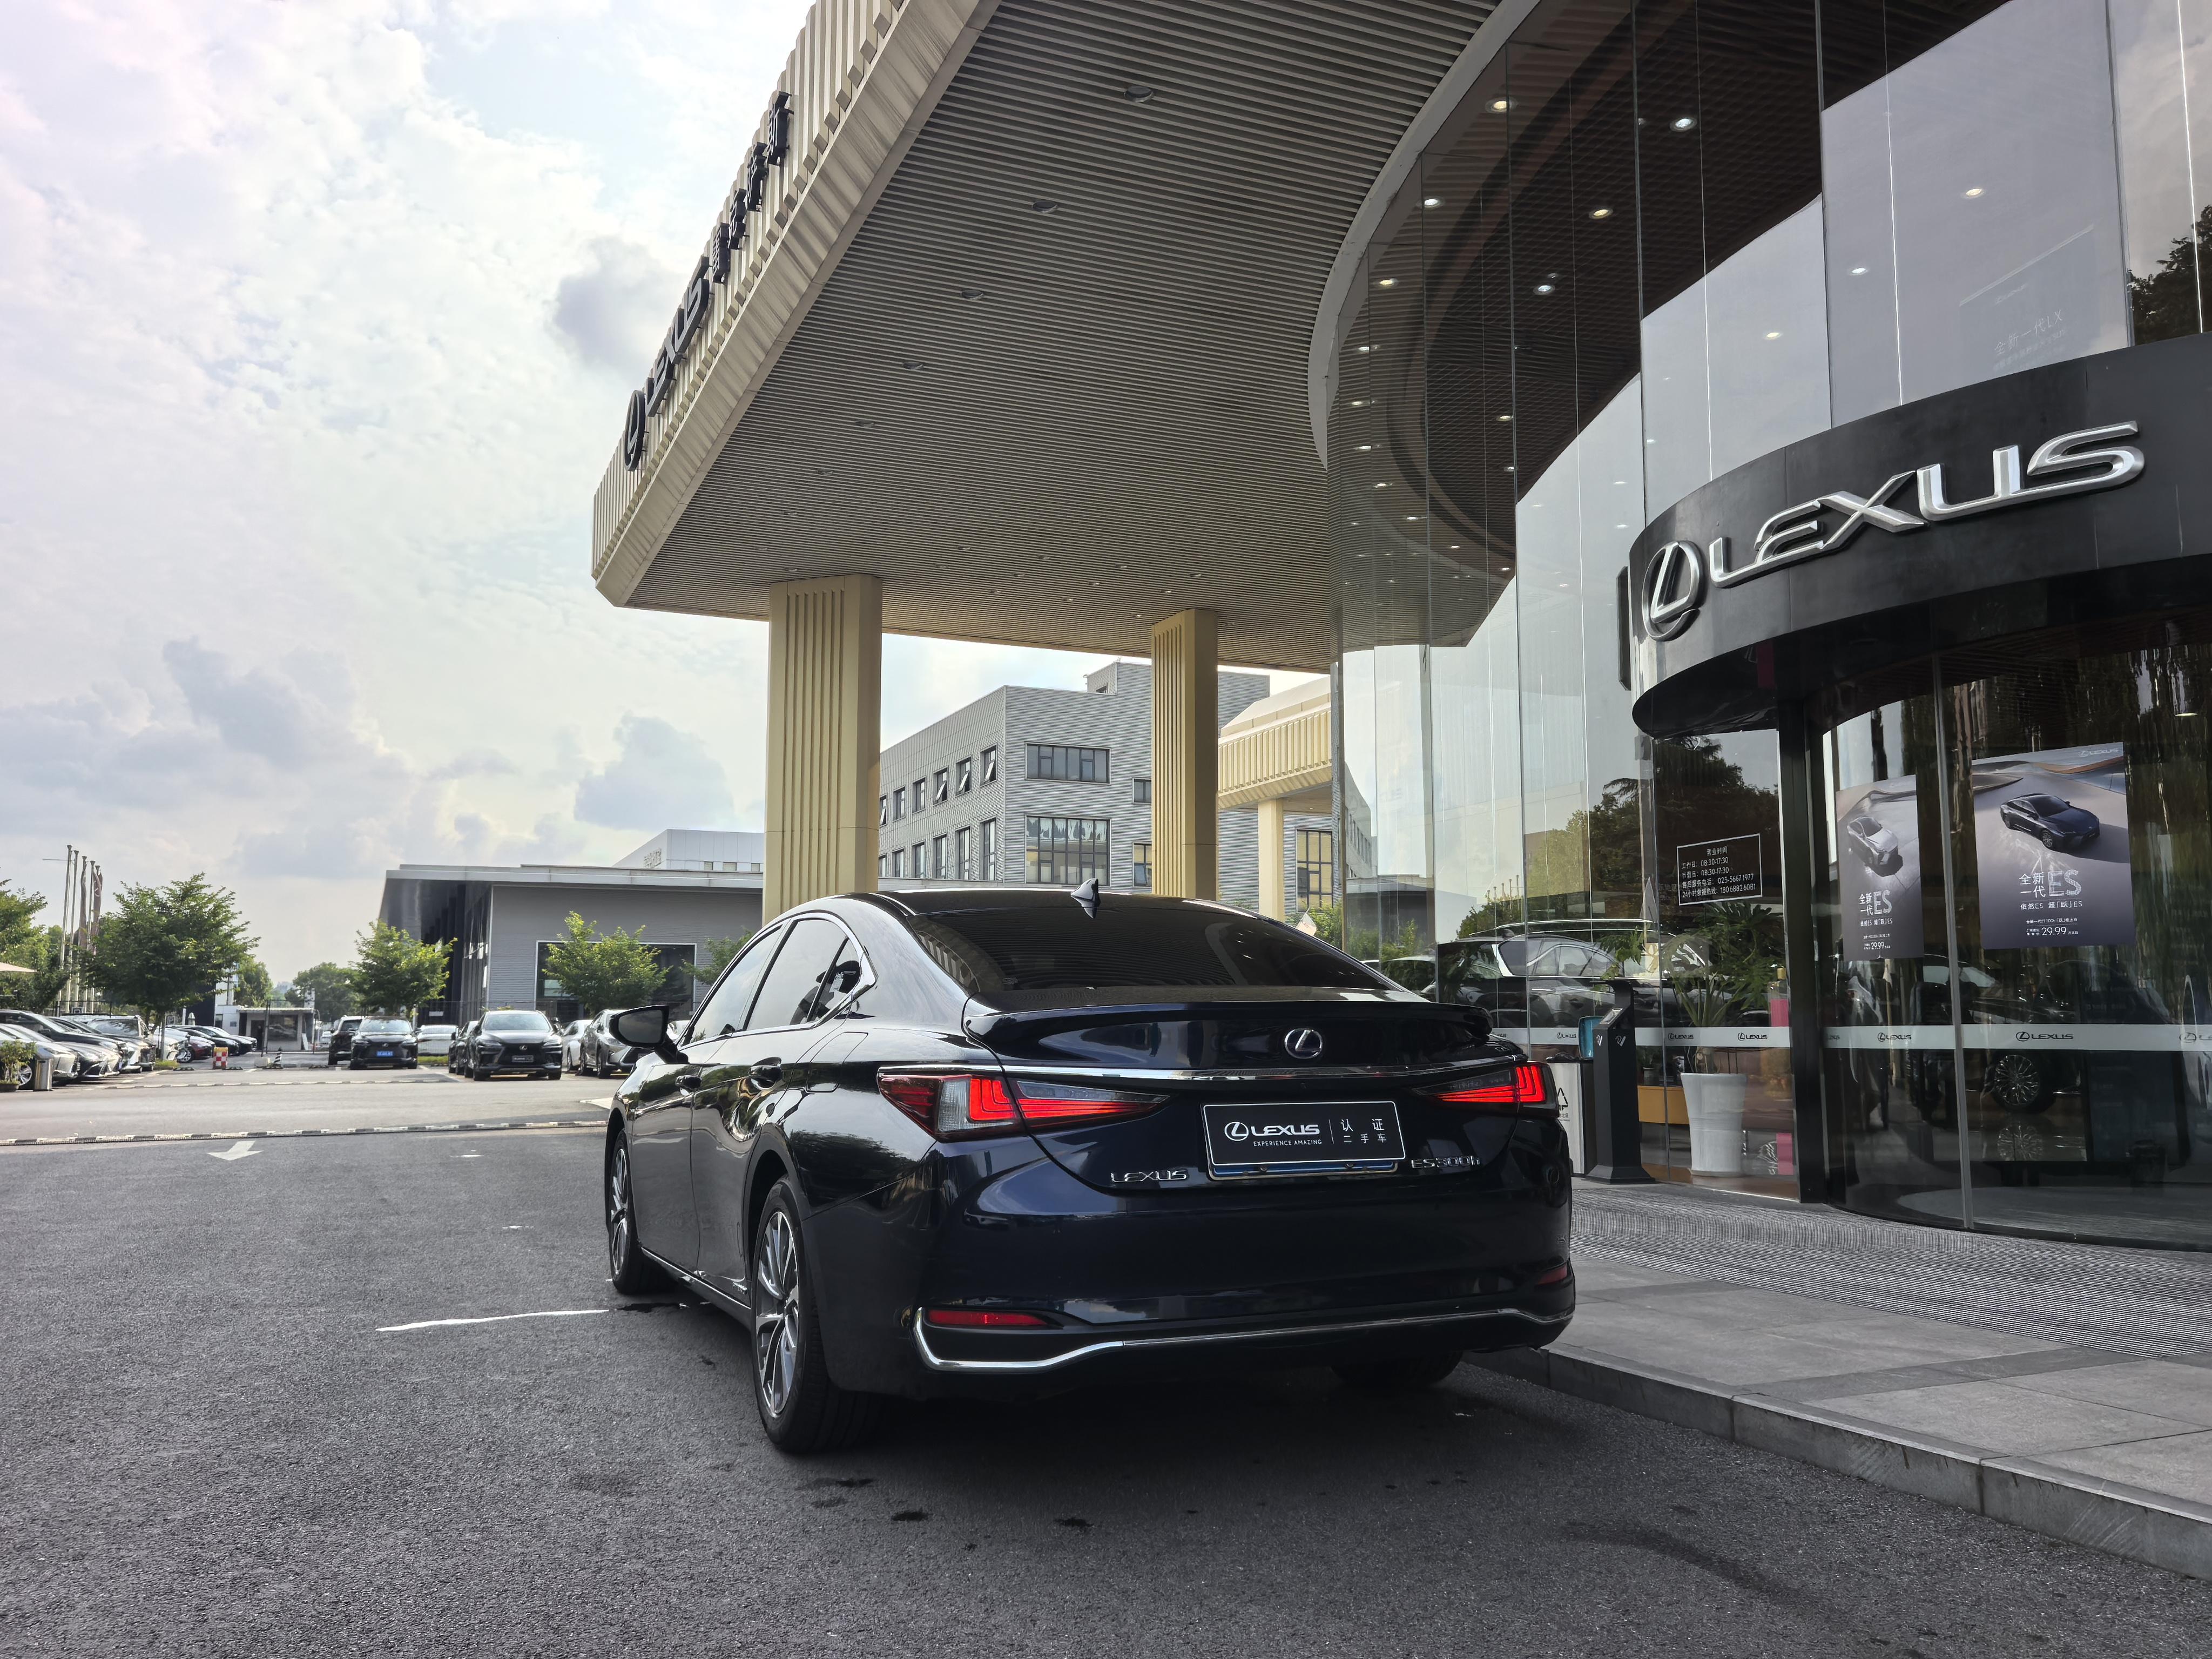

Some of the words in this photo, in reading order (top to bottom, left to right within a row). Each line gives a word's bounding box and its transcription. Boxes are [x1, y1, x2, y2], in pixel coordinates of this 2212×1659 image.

[645, 255, 710, 417] LEXUS
[1709, 420, 2145, 588] LEXUS
[1707, 846, 1728, 856] 营业时间
[1701, 857, 1729, 867] 08:30-17:30
[1701, 866, 1729, 876] 08:30-17:30
[2048, 869, 2082, 896] ES
[1873, 889, 1892, 914] ES
[2041, 926, 2067, 936] 29.99
[1250, 1124, 1320, 1136] LEXUS
[1110, 1170, 1187, 1183] LEXUS
